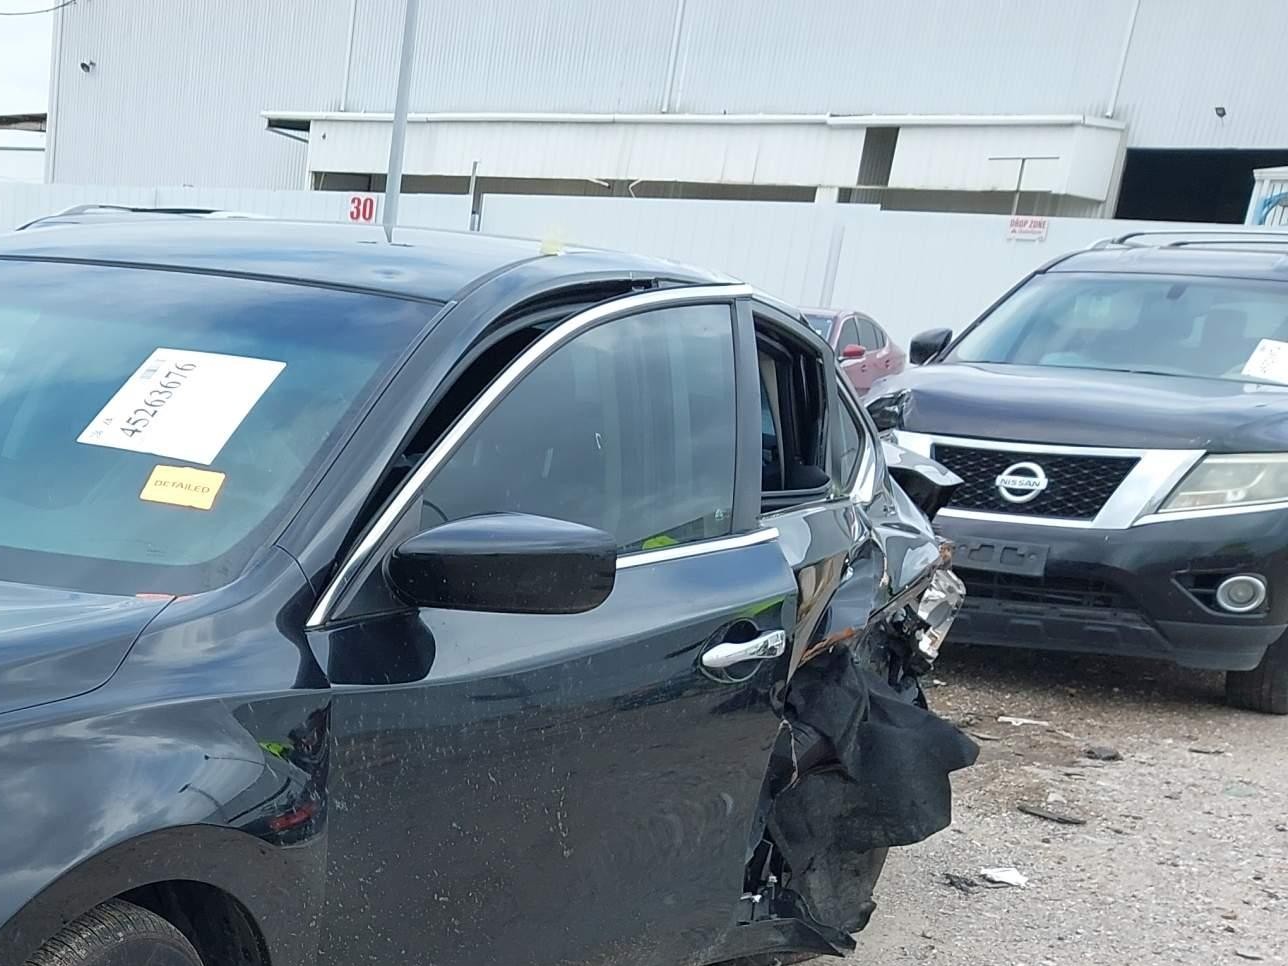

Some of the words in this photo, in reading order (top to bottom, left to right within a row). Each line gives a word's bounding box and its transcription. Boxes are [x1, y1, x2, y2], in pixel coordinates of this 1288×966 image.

[350, 196, 374, 221] 30
[120, 362, 197, 438] 45263676
[154, 480, 210, 494] DETAILED
[1000, 478, 1041, 487] NISSAN
